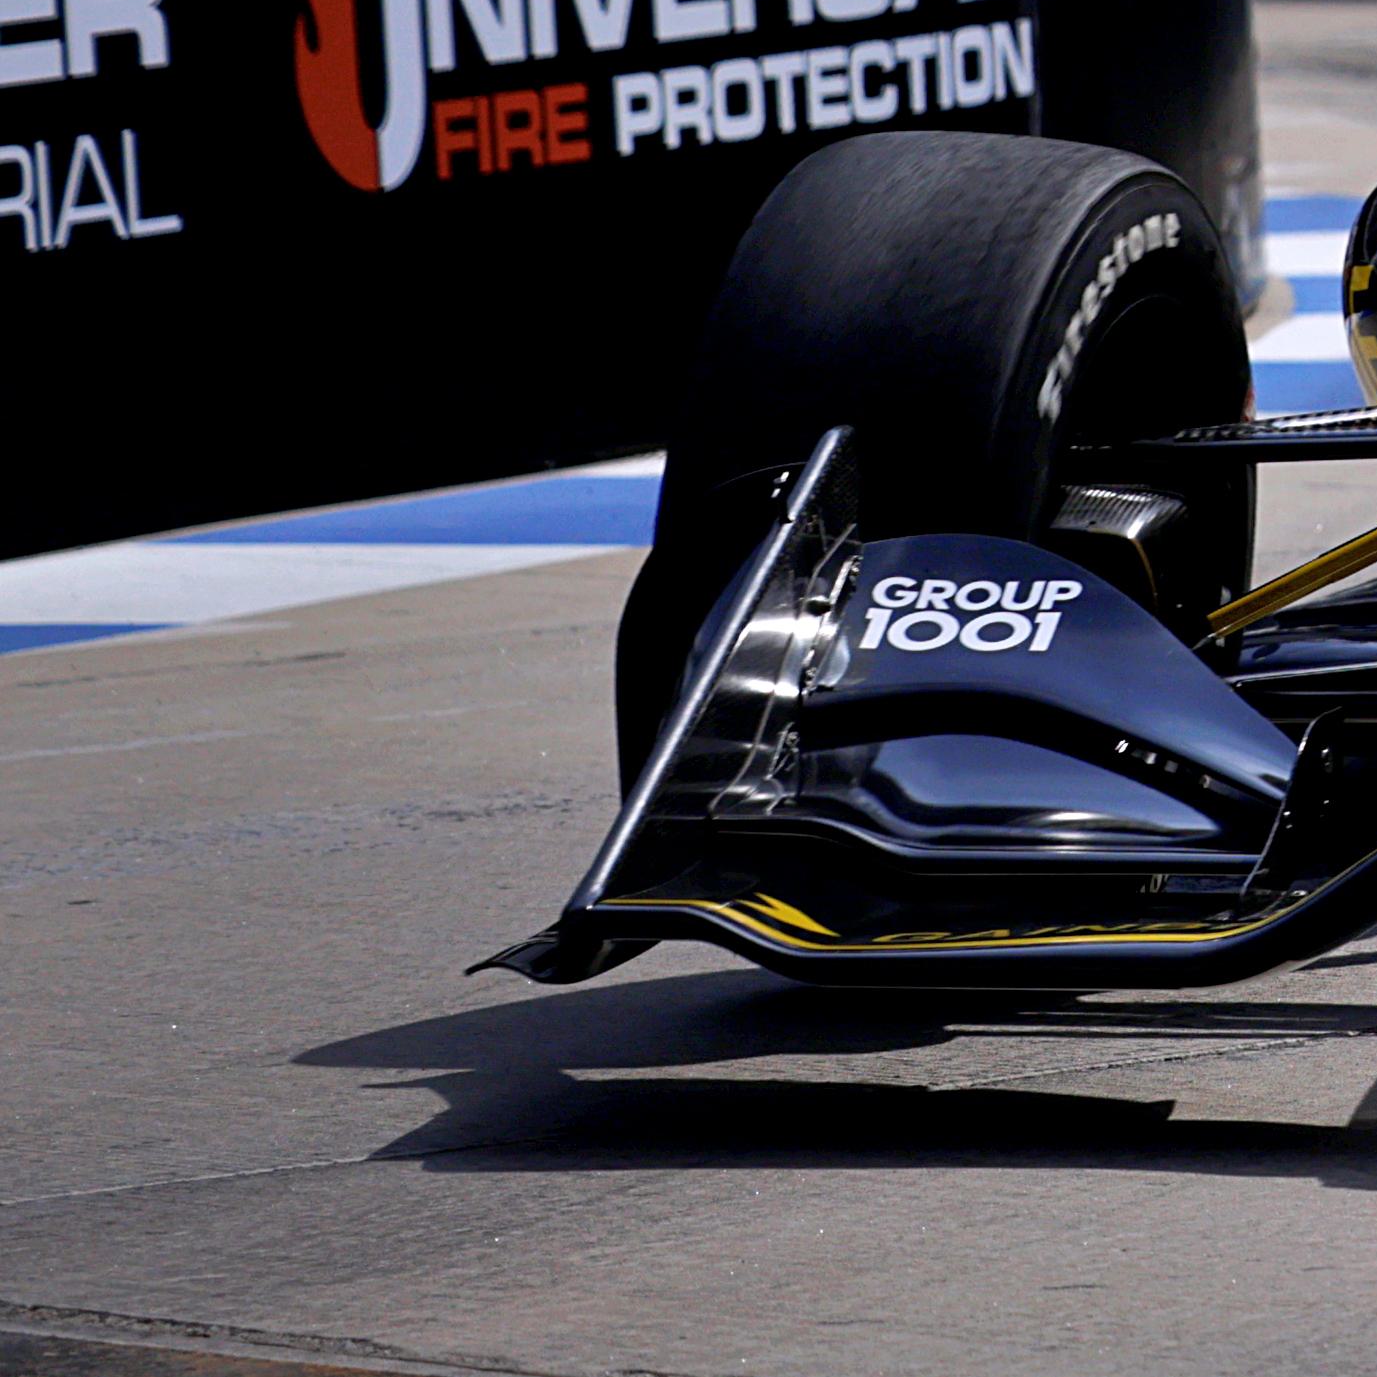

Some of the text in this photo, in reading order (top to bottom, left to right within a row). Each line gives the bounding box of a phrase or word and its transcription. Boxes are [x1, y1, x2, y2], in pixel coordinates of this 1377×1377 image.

[432, 19, 1034, 181] FIRE PROTECTION
[1037, 212, 1181, 425] Firestone
[858, 607, 1062, 653] 1001
[872, 576, 1083, 611] GROUP
